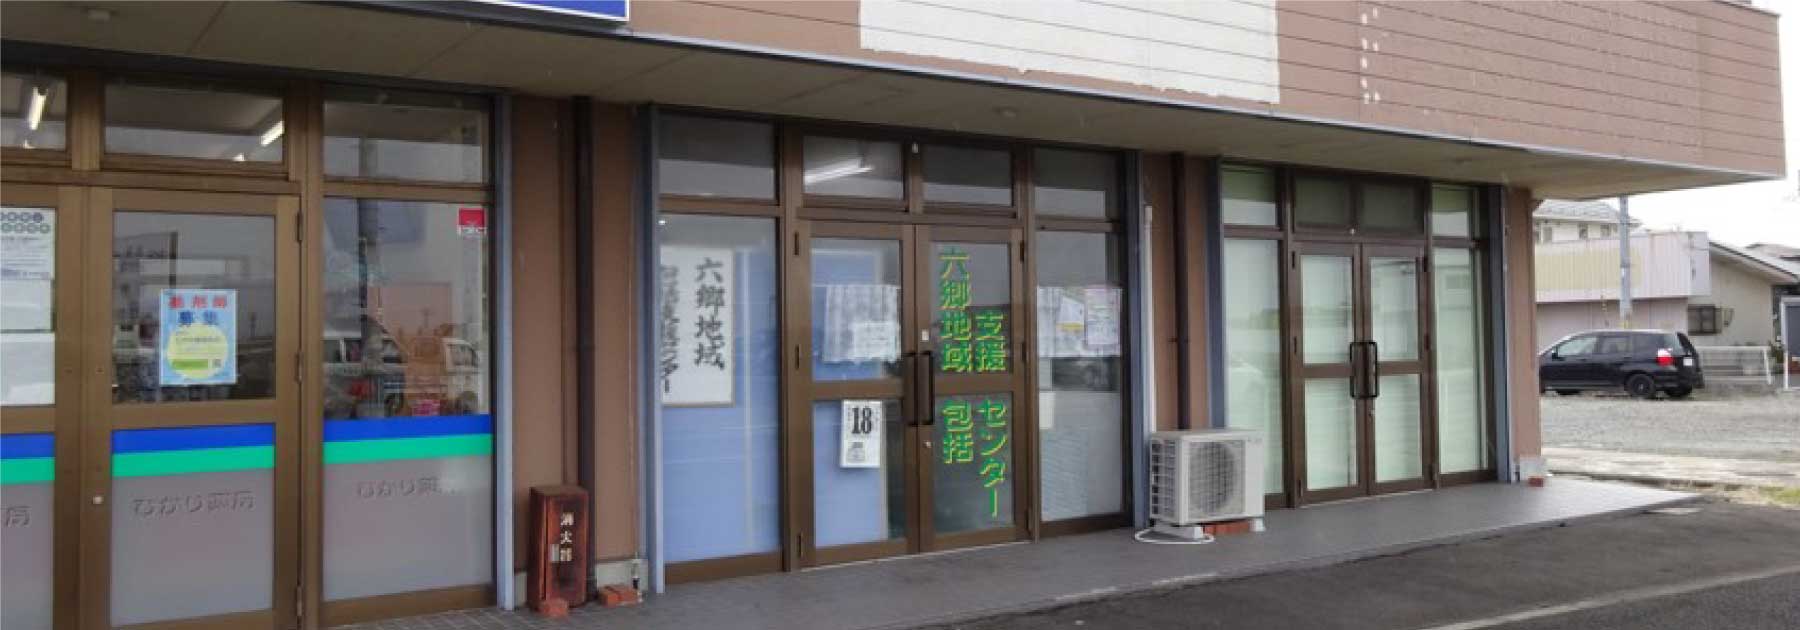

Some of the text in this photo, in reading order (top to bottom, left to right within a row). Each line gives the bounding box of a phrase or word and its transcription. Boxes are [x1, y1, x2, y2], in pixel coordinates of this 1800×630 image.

[695, 257, 725, 370] 六郷地域
[939, 246, 974, 464] 六郷地域 包括
[852, 406, 872, 434] 18
[975, 310, 1007, 517] 支援 センター
